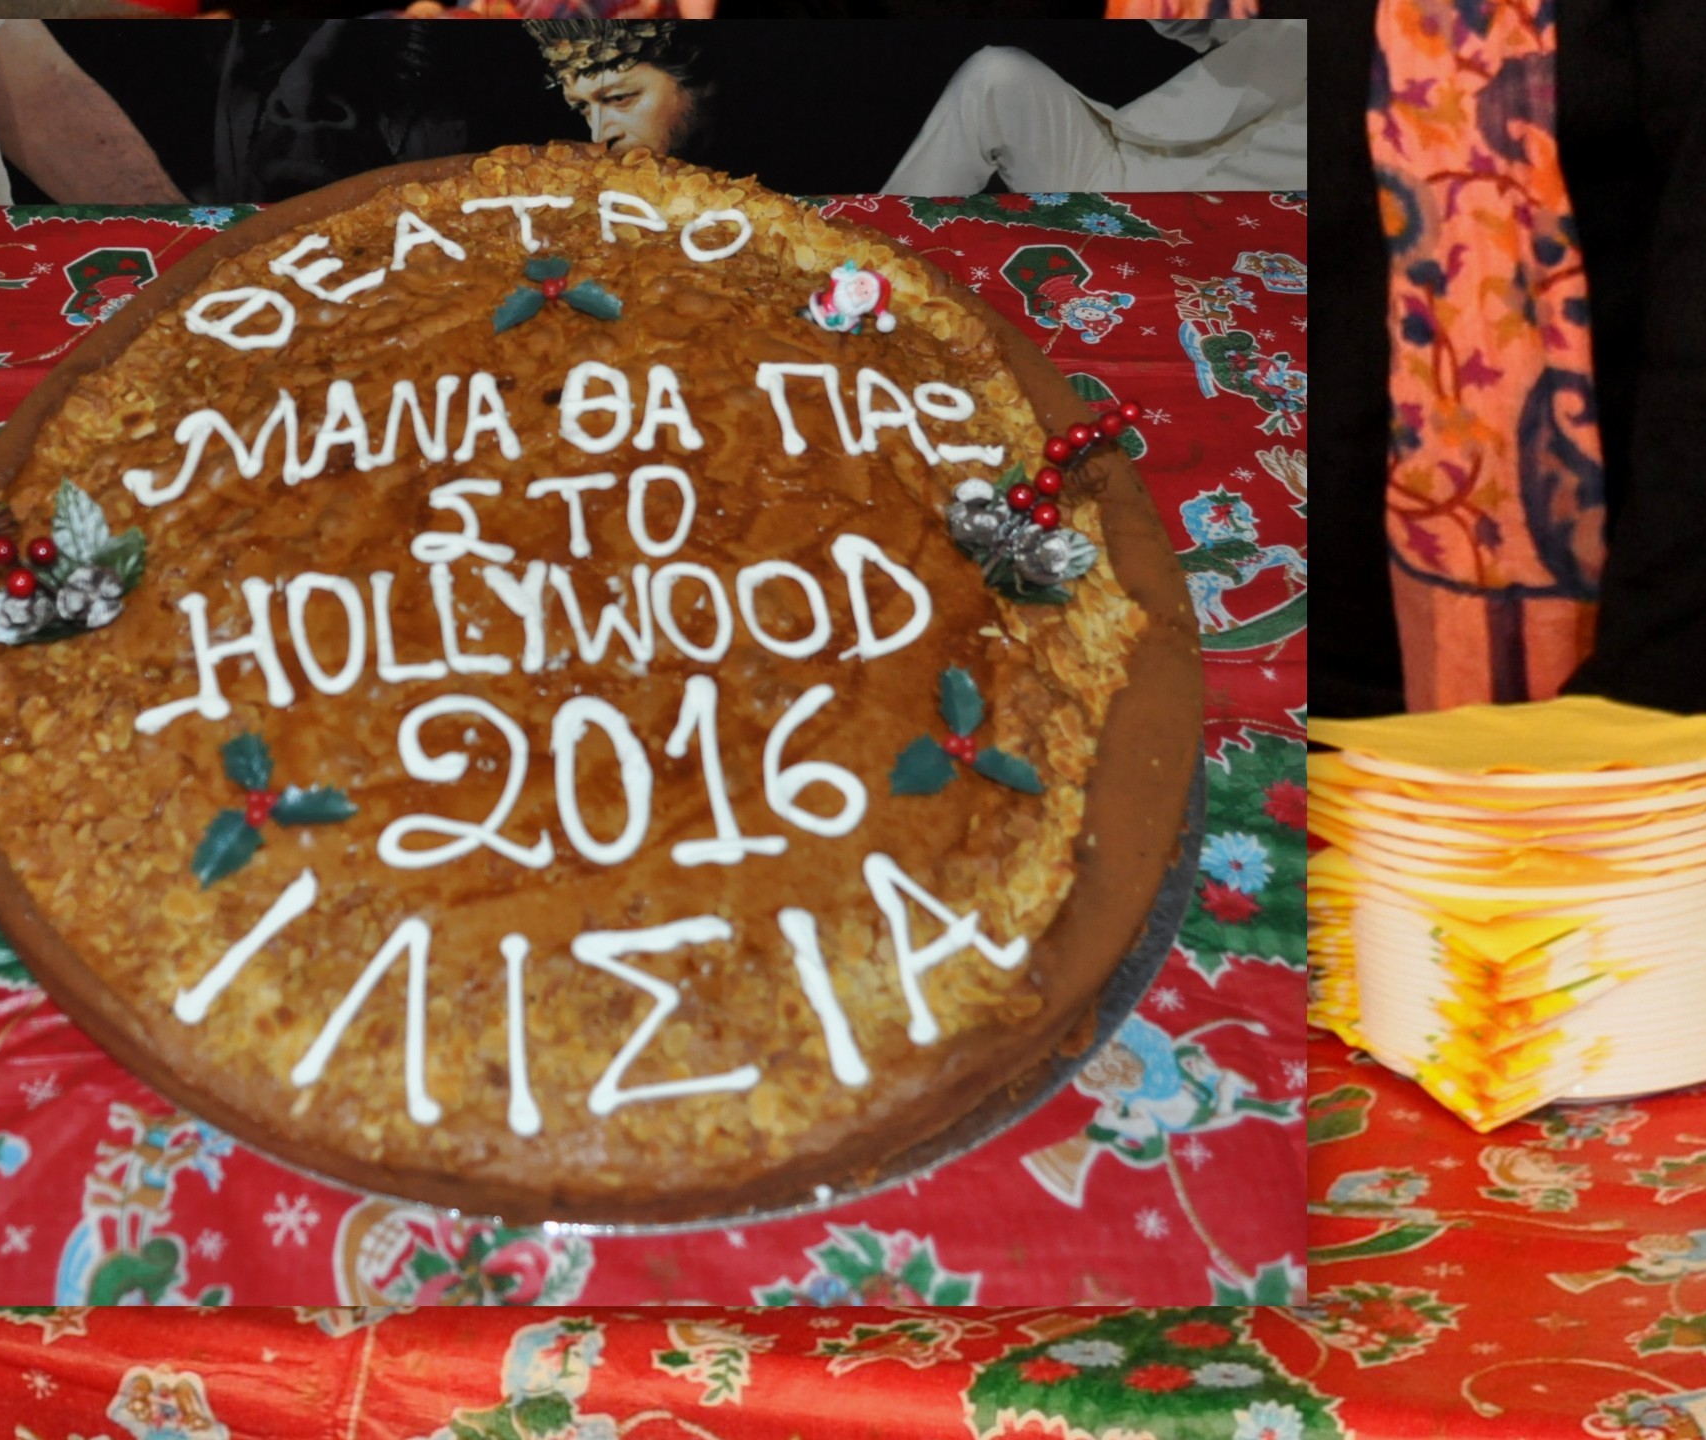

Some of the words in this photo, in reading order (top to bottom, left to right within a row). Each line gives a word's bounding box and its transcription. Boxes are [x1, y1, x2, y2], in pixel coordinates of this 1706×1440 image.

[184, 192, 752, 351] ΘΕΑΤΡΟ
[123, 370, 523, 506] ΜΑΝΑ
[557, 360, 704, 455] ΘΑ
[413, 464, 697, 562] ΣΤΟ
[133, 533, 934, 734] HOLLYWOOD
[376, 673, 869, 870] 2016
[171, 851, 1031, 1140] ΙΛΙΣΙΑ
